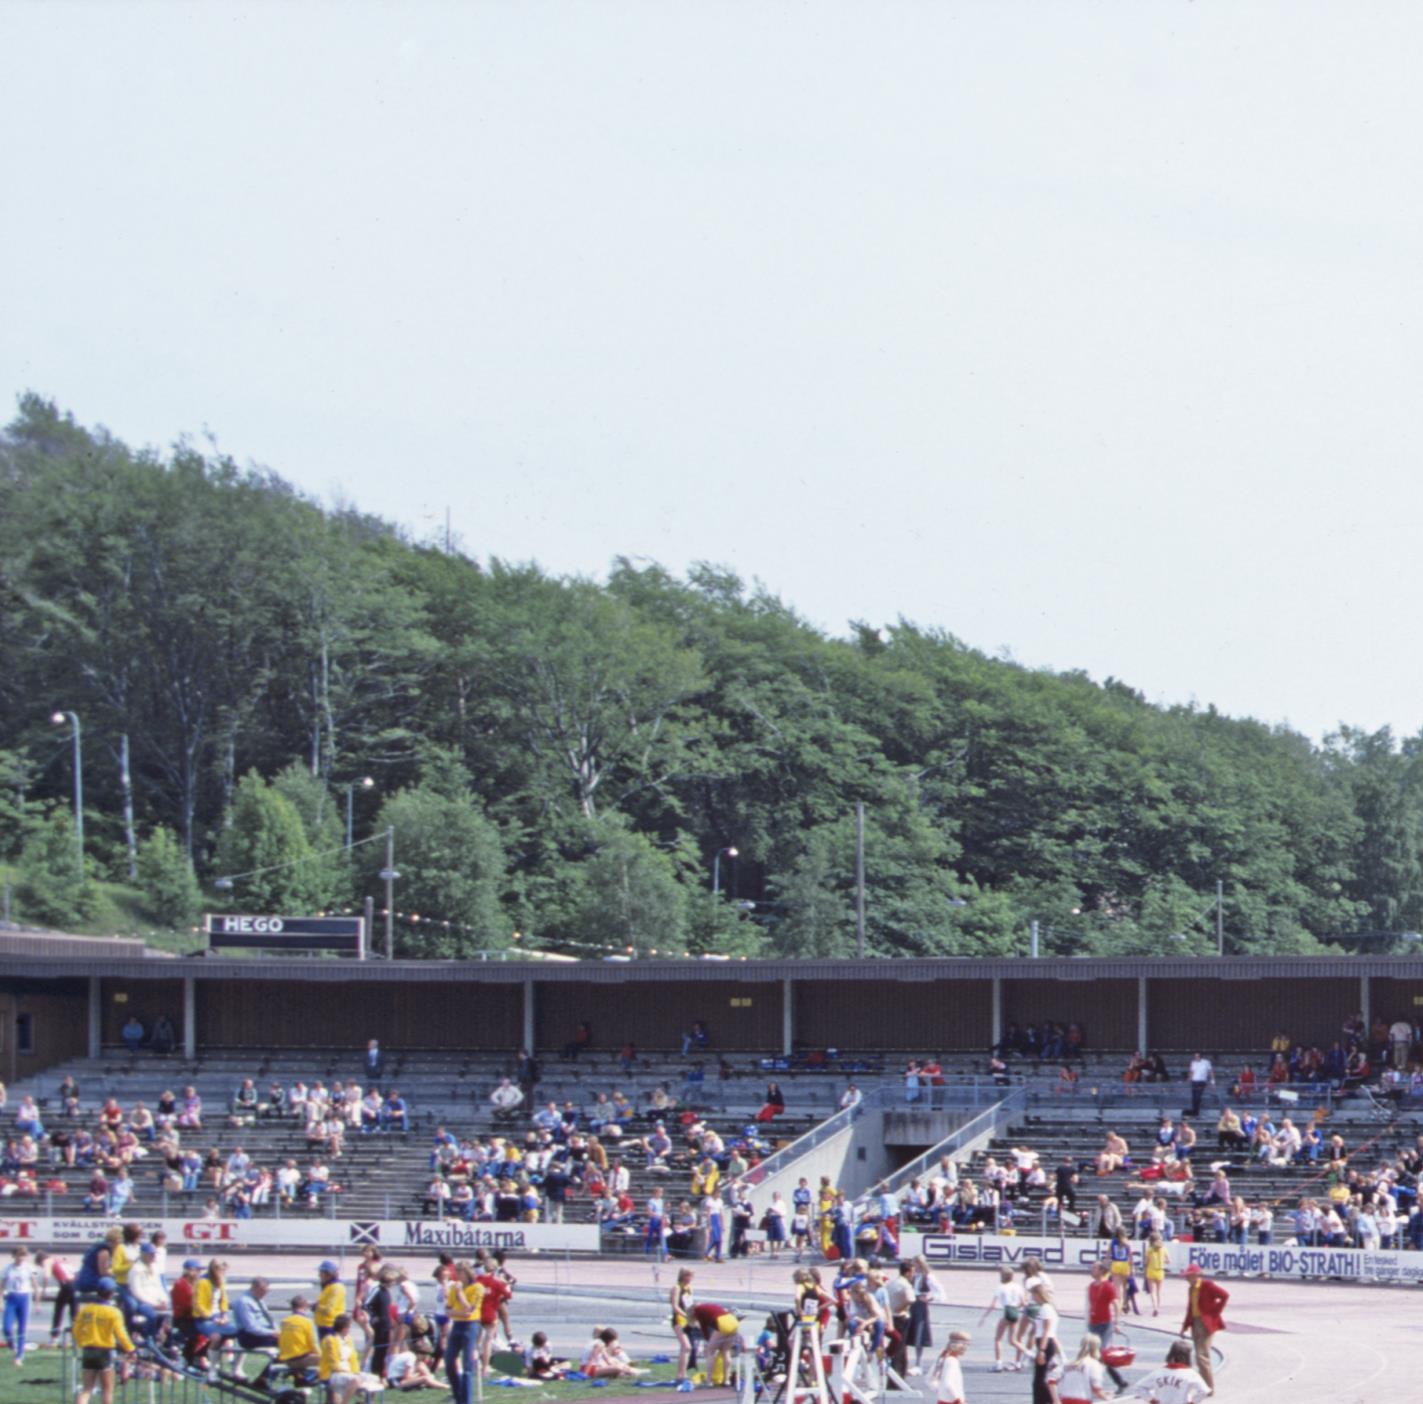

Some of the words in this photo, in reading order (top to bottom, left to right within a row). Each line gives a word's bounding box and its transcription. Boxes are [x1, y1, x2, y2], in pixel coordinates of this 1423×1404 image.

[223, 917, 284, 933] HEGO
[183, 1222, 239, 1240] GT
[404, 1222, 526, 1247] Maxibåtarna
[922, 1235, 1065, 1263] Gislaved
[1189, 1247, 1220, 1270] Före
[1224, 1246, 1264, 1272] målet
[1269, 1251, 1360, 1275] BIO-STRATH!
